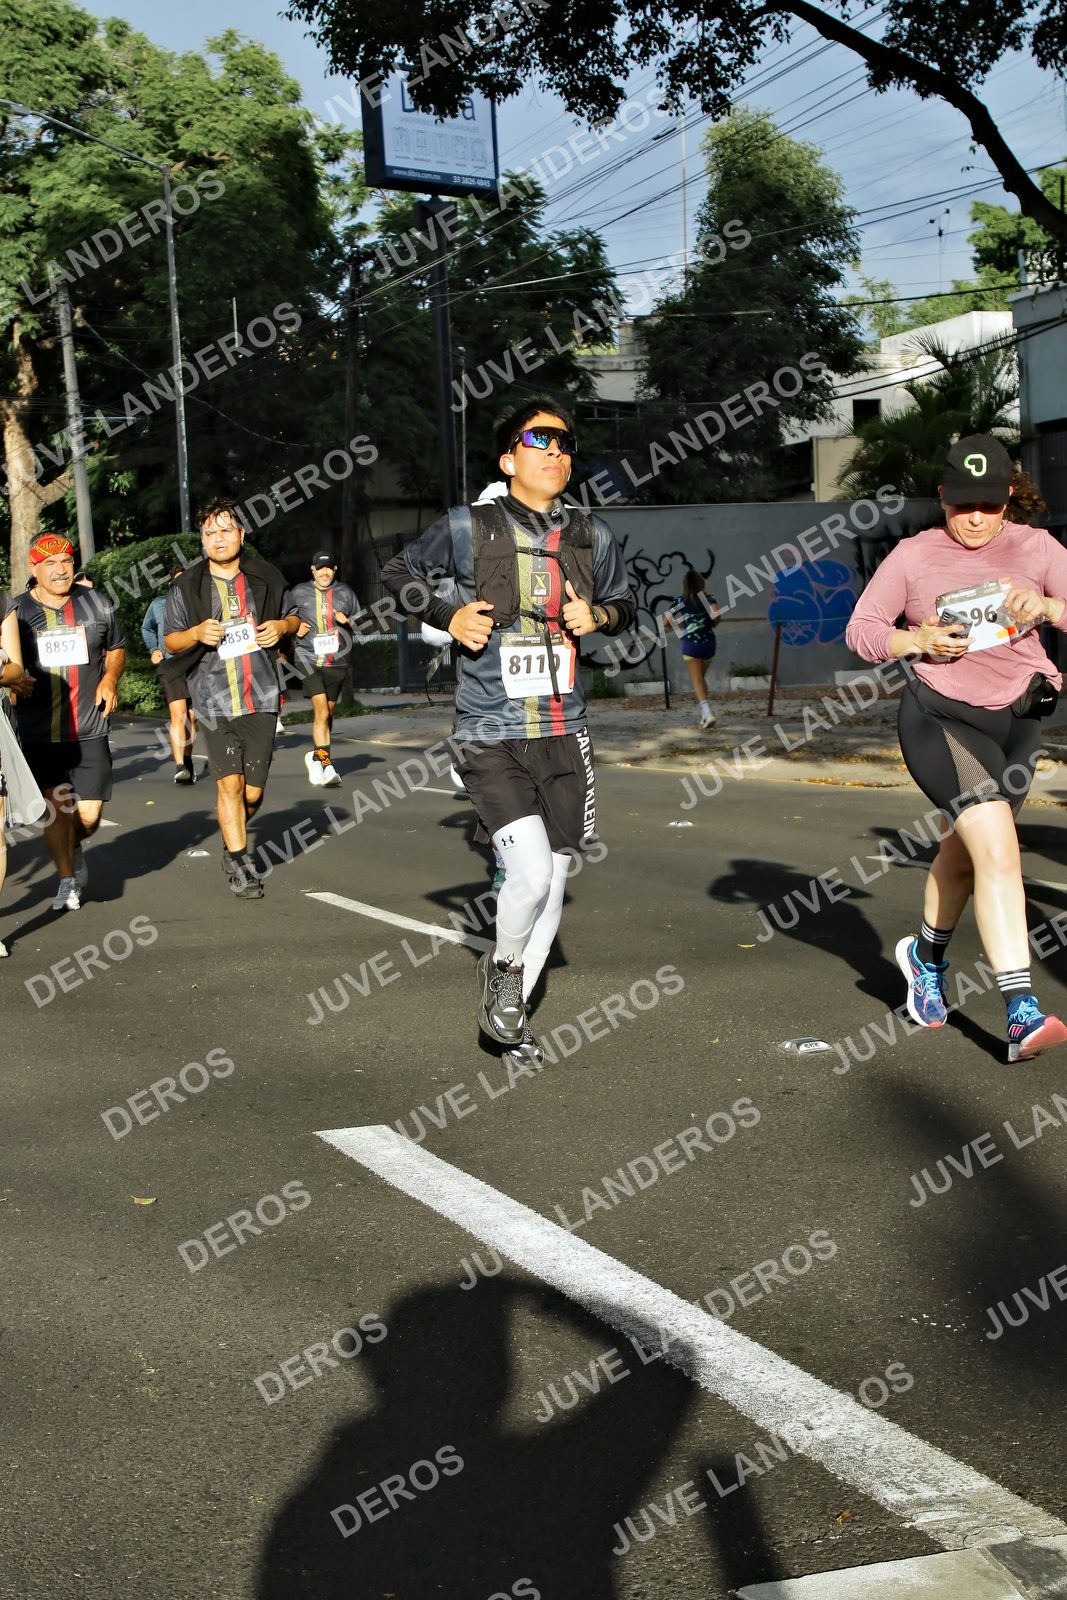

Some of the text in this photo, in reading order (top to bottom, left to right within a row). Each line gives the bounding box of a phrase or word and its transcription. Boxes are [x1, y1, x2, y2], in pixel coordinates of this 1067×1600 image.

[958, 604, 997, 627] 96
[45, 640, 76, 654] 8857
[576, 726, 596, 838] CALVIN KLEIN
